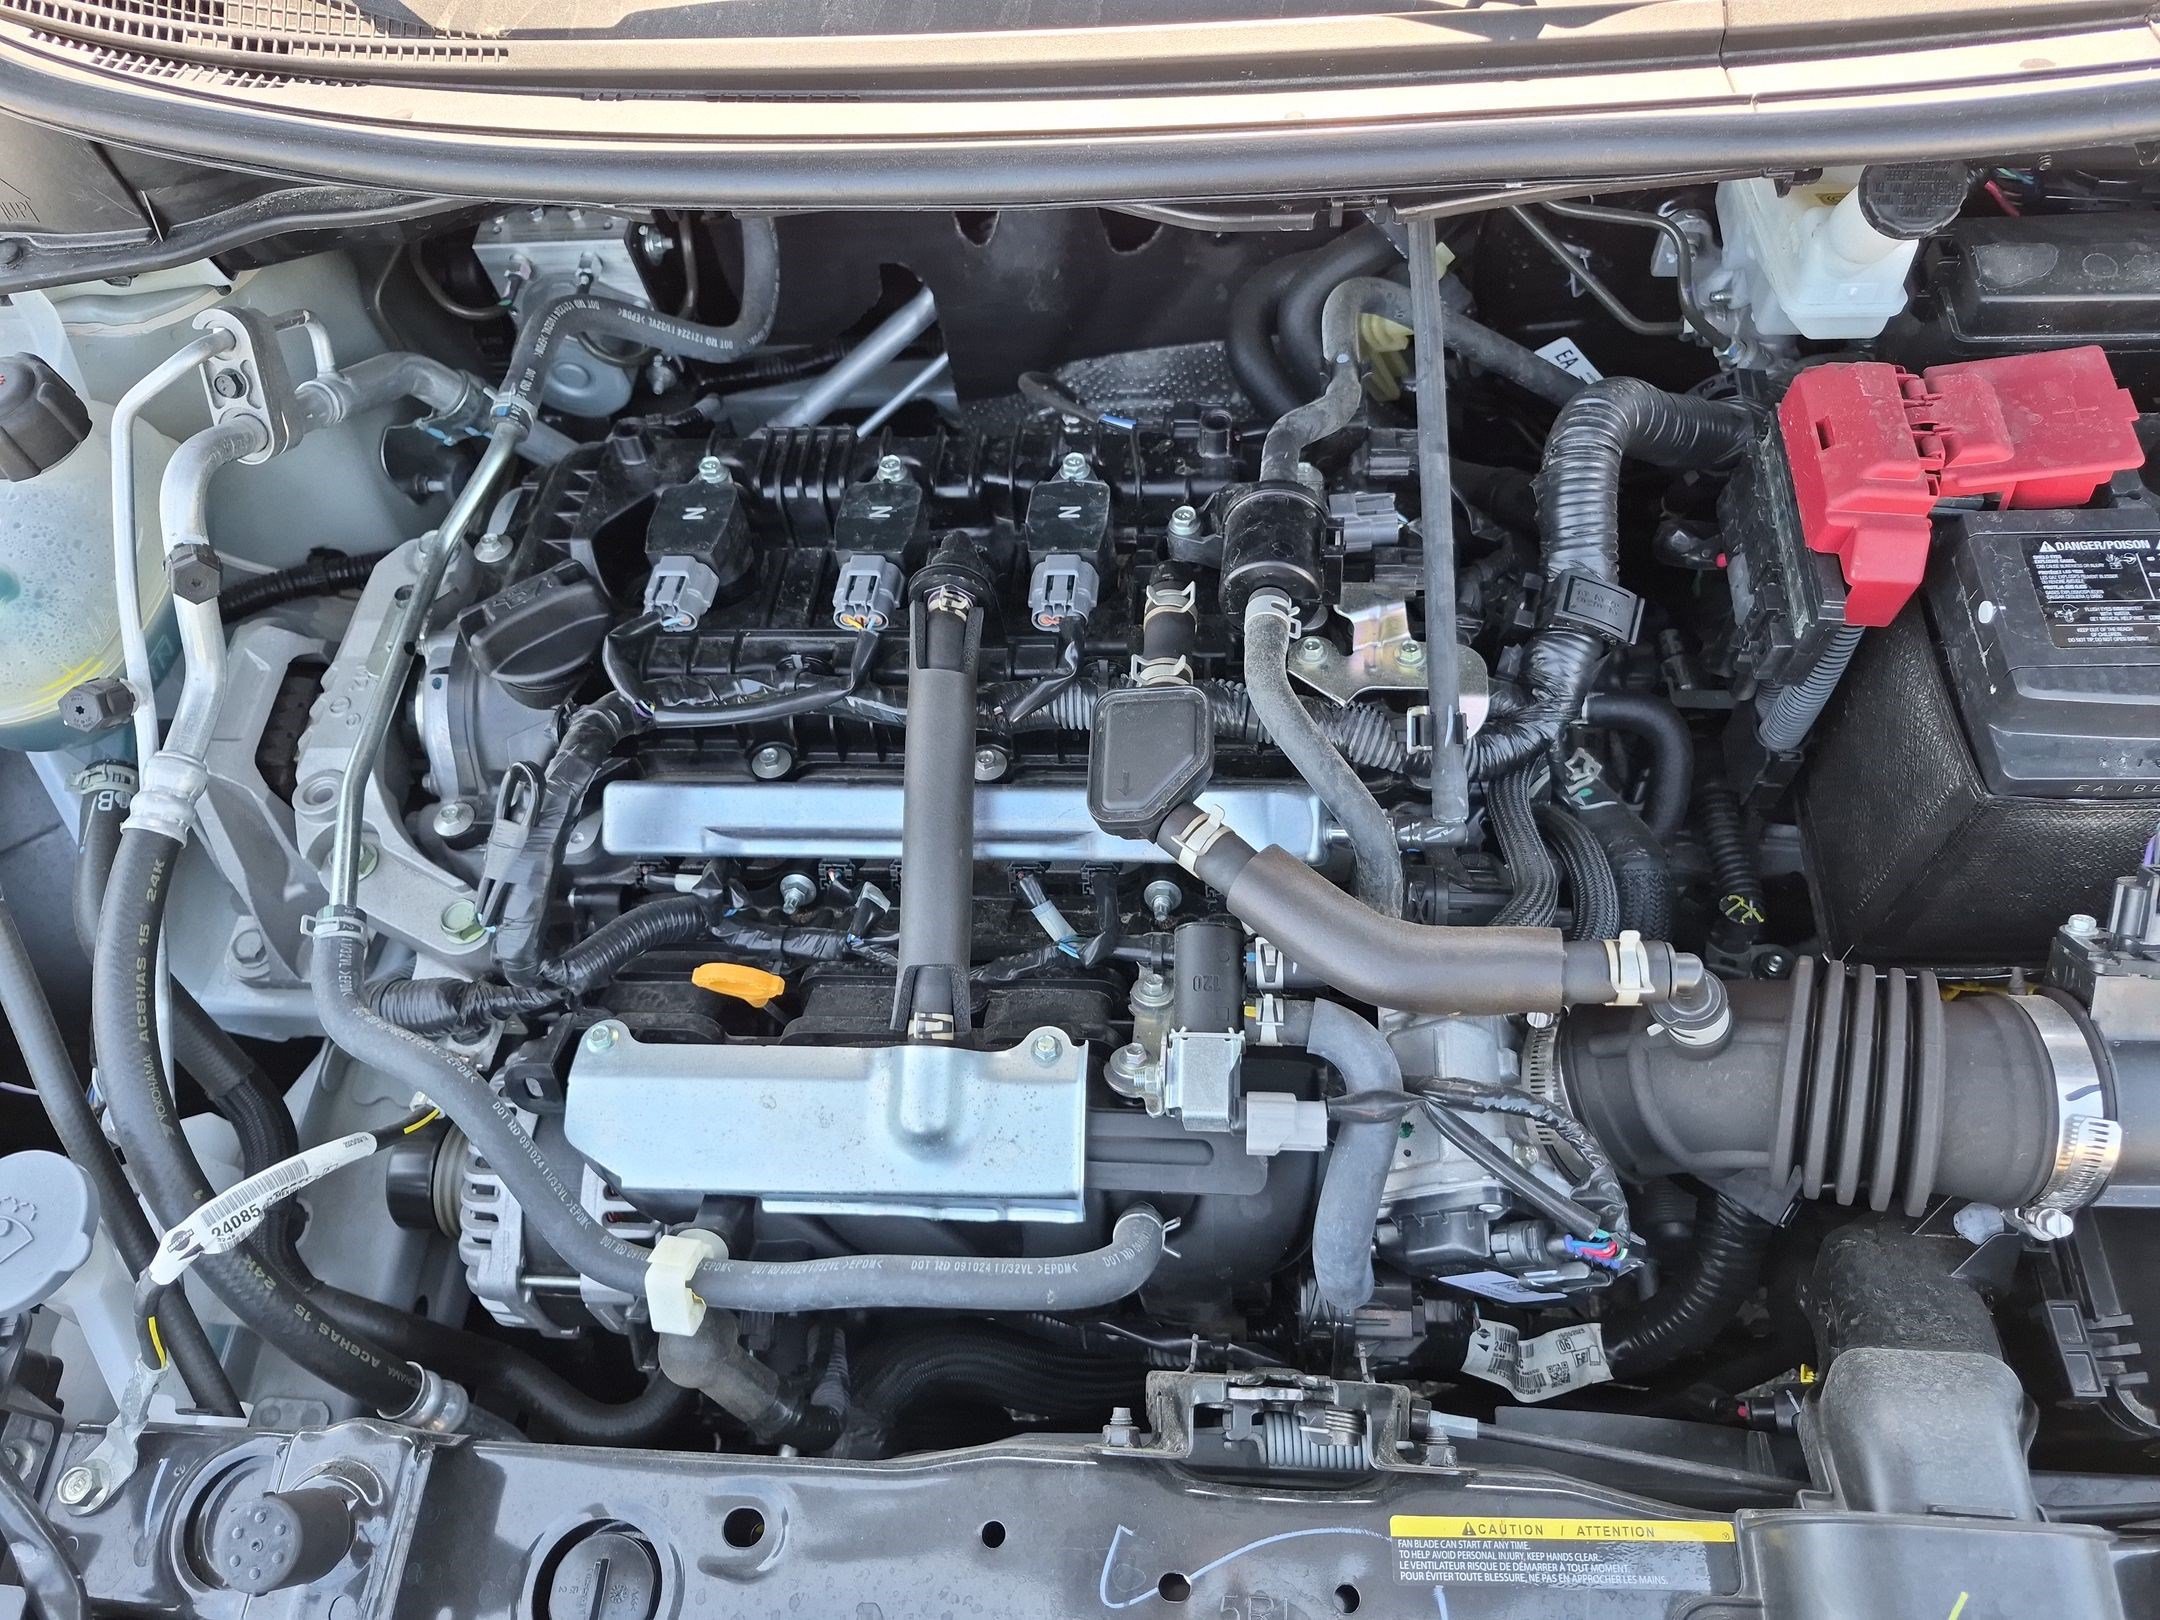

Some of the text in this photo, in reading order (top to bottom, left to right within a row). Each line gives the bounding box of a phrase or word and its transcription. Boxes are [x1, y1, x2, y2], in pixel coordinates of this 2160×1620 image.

[677, 326, 704, 344] 121224
[1555, 349, 1579, 370] EA
[2055, 540, 2151, 551] DANGER/POISON
[146, 858, 166, 902] 24K
[138, 923, 150, 947] 15
[143, 1054, 168, 1122] YOKOHAMA
[492, 1102, 510, 1120] DOT
[519, 1135, 545, 1170] 091024
[542, 1167, 566, 1202] 11/32VL
[566, 1199, 592, 1231] >EPDM<
[211, 1203, 262, 1238] 24085
[842, 1258, 883, 1270] >EPDM<
[911, 1259, 930, 1271] DOT
[954, 1260, 991, 1273] 091024
[994, 1262, 1034, 1275] 11/32VL
[1036, 1262, 1079, 1276] >EPDM<
[1104, 1251, 1122, 1268] DOT
[294, 1303, 312, 1323] 15
[1478, 1523, 1544, 1536] CAUTION
[1577, 1525, 1656, 1538] ATTENTION
[1398, 1539, 1531, 1550] FAN BLADE CAN START AT ANY TIME.
[1399, 1550, 1600, 1562] TO HELP AVOID PERSONAL INJURY, KEEP HANDS CLEAR.
[1399, 1560, 1630, 1573] LE VENTILATEUR RISQUE DE DÉMARRER À TOUT MOMENT.
[1400, 1570, 1668, 1585] POUR ÉVITER TOUTE BLESSURE, NE PAS EN APPROCHER LES MAINS.
